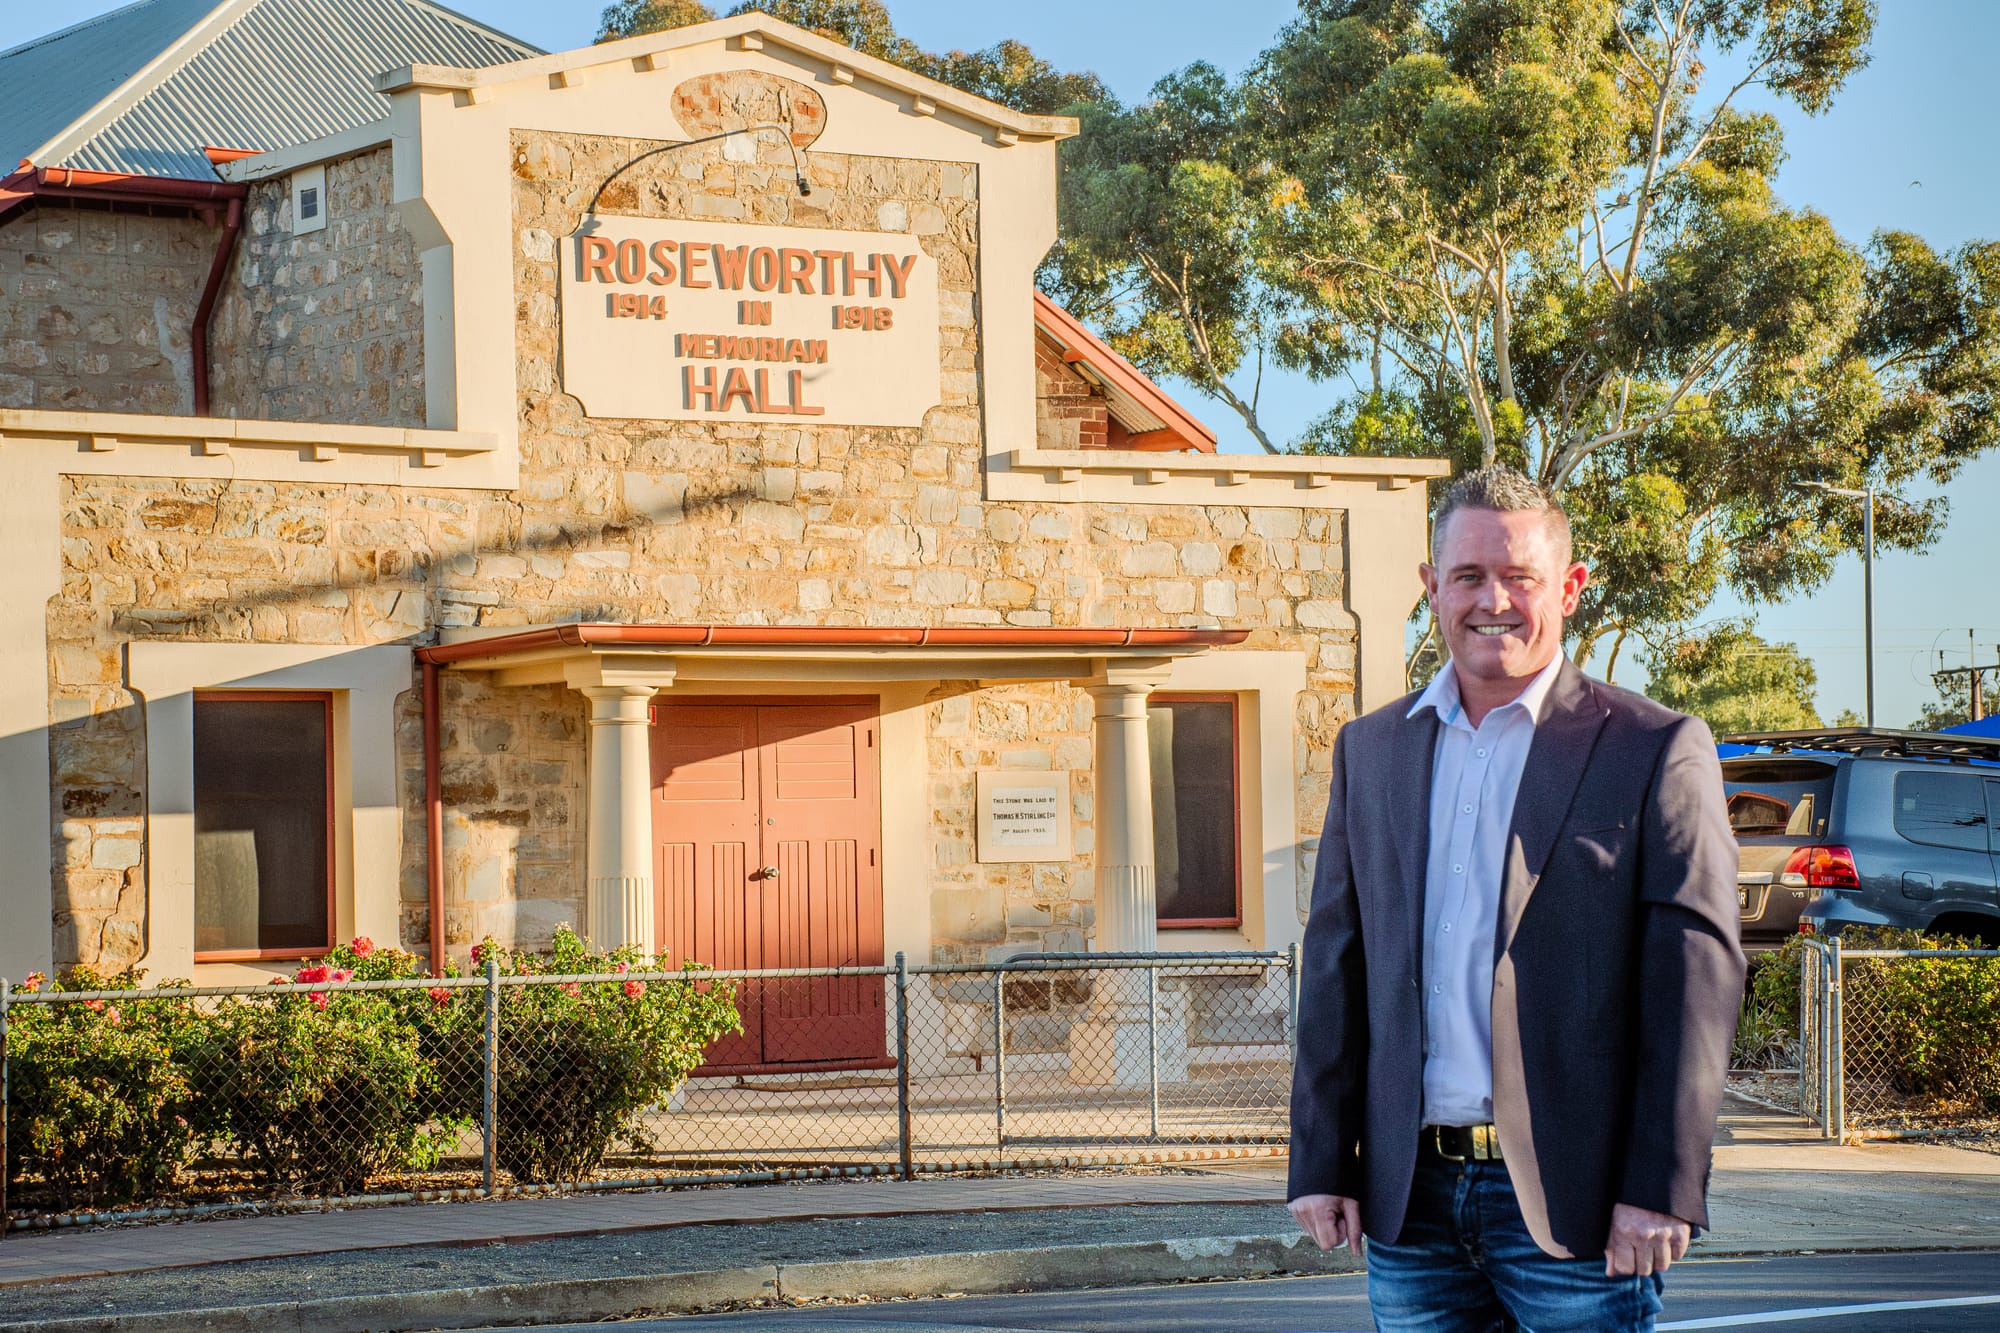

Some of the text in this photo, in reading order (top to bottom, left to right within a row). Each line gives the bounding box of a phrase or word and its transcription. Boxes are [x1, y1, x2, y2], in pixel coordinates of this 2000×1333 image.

[575, 235, 917, 298] ROSEWORTHY
[606, 292, 893, 331] 1914 IN 1918
[675, 332, 828, 364] MEMORIAM
[681, 365, 825, 416] HALL
